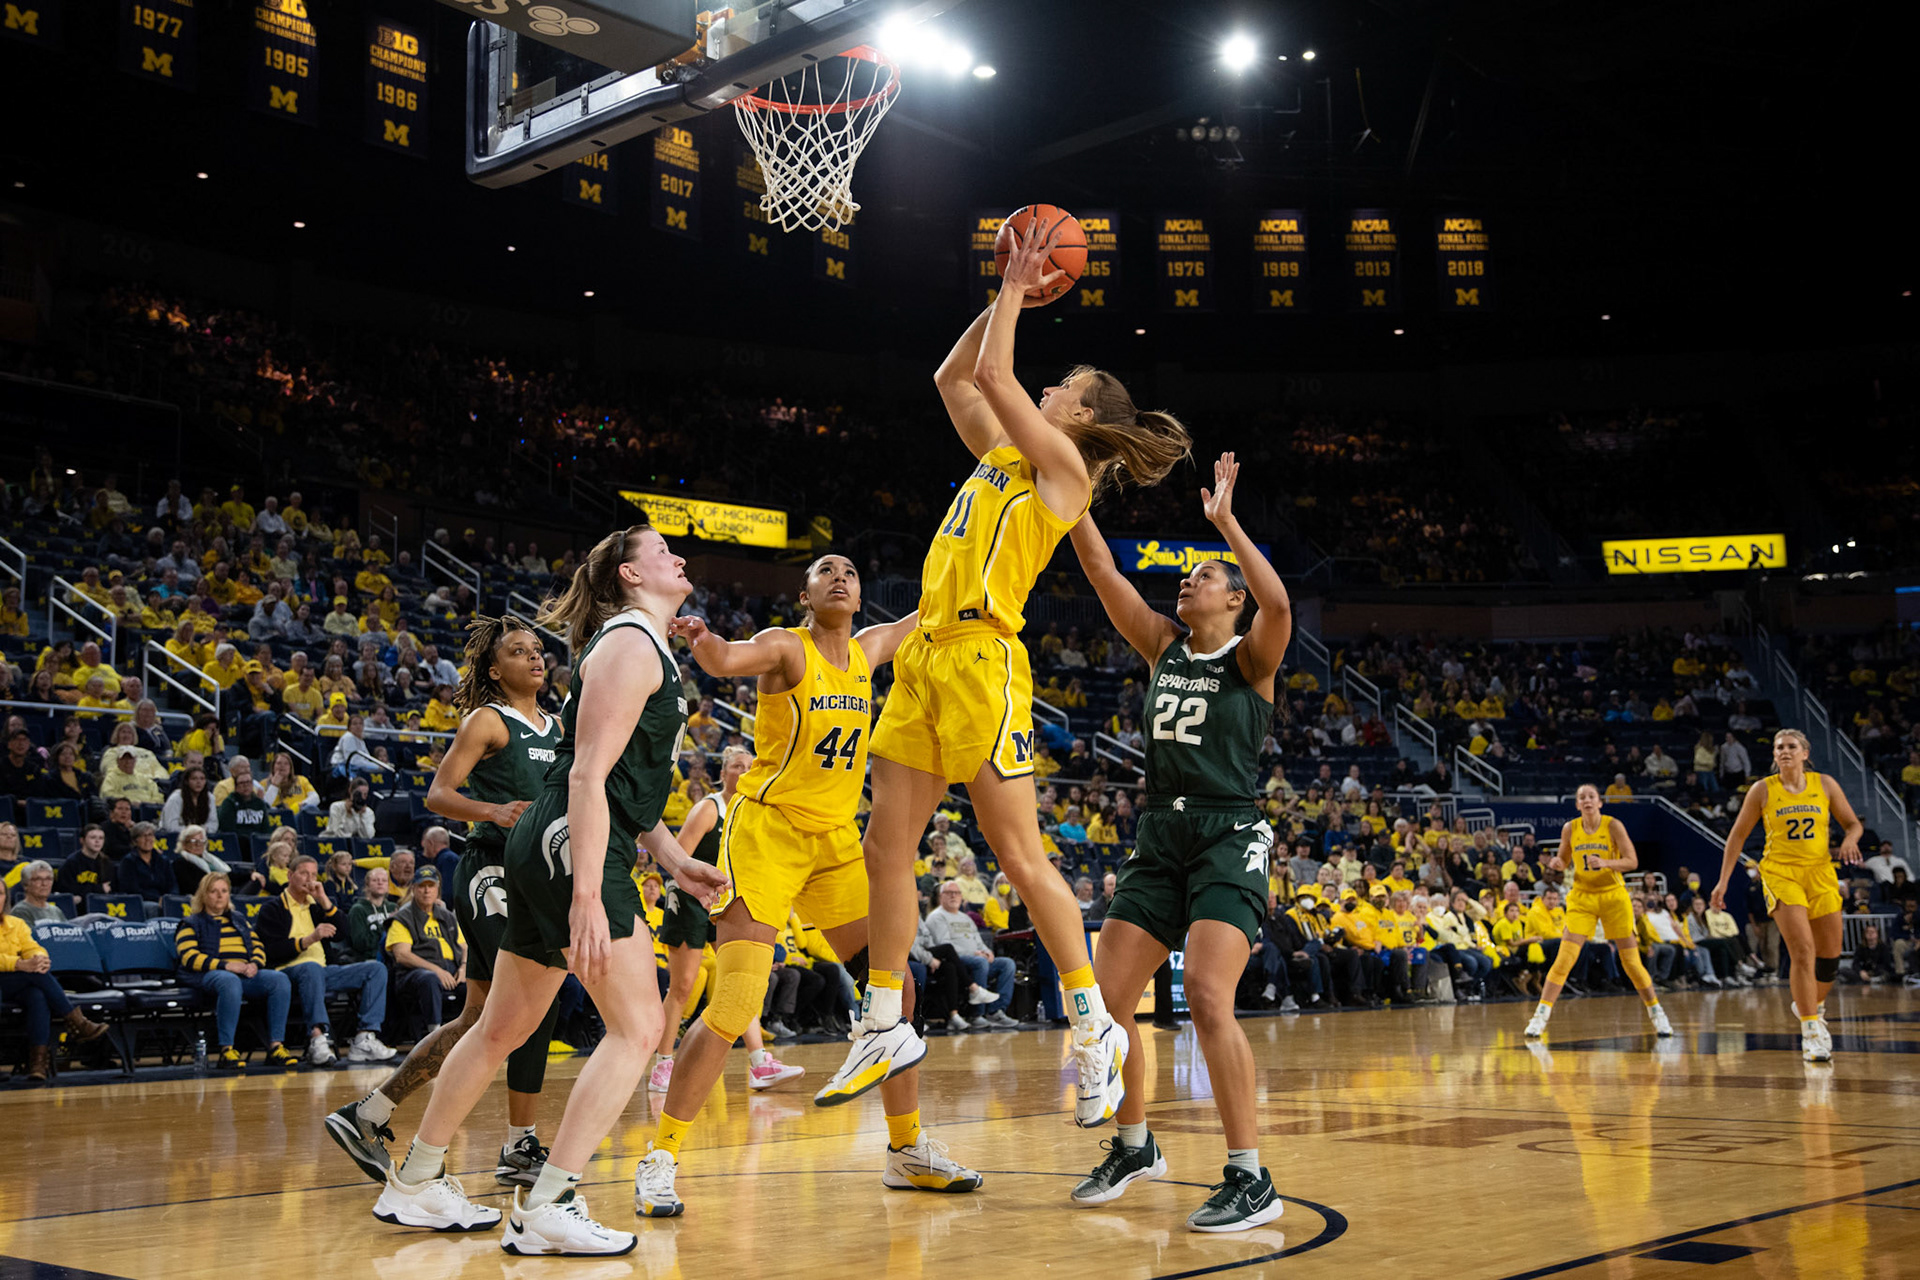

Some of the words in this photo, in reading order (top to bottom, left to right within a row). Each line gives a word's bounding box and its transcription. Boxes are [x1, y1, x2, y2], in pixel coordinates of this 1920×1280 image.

[4, 2, 39, 36] M
[134, 4, 183, 38] 1977
[142, 46, 173, 78] M
[265, 46, 309, 78] 1985
[369, 44, 427, 74] CHAMPIONS
[269, 85, 298, 114] M
[377, 81, 418, 112] 1986
[383, 119, 410, 147] M
[579, 179, 602, 204] M
[661, 173, 694, 199] 2017
[666, 205, 687, 231] M
[978, 218, 1006, 231] NC
[1164, 219, 1203, 232] NCAA
[1259, 219, 1298, 232] NCAA
[1351, 219, 1390, 232] NCAA
[1444, 219, 1483, 231] NCAA
[748, 232, 769, 256] M
[822, 226, 850, 251] 2021
[826, 257, 845, 280] M
[980, 261, 996, 276] 19
[1083, 261, 1110, 276] 965
[1168, 261, 1205, 277] 1976
[1263, 262, 1299, 277] 1989
[1355, 261, 1391, 276] 2013
[1448, 260, 1484, 276] 2018
[1080, 289, 1105, 306] M
[1175, 289, 1199, 306] M
[1270, 289, 1294, 307] M
[1362, 289, 1386, 306] M
[1455, 288, 1479, 306] M
[973, 463, 1011, 493] IGAN
[703, 506, 720, 518] OF
[723, 509, 785, 526] MICHIGAN
[942, 490, 976, 538] 11
[648, 512, 689, 527] CREDI
[714, 521, 755, 535] UNION
[1614, 543, 1774, 566] NISSAN
[1157, 673, 1221, 693] SPARTANS
[1153, 693, 1208, 746] 22
[814, 726, 862, 770] 44
[1011, 729, 1034, 763] M
[44, 806, 63, 818] M
[1776, 805, 1822, 817] MICHIGAN
[269, 815, 282, 827] M
[1786, 818, 1815, 840] 22
[24, 835, 43, 848] M
[209, 840, 225, 852] M
[318, 843, 334, 855] M
[367, 844, 383, 857] M
[1574, 844, 1609, 852] MICHIGAN
[106, 903, 127, 917] M
[52, 926, 82, 937] Ruoff
[126, 927, 155, 937] Ruoff
